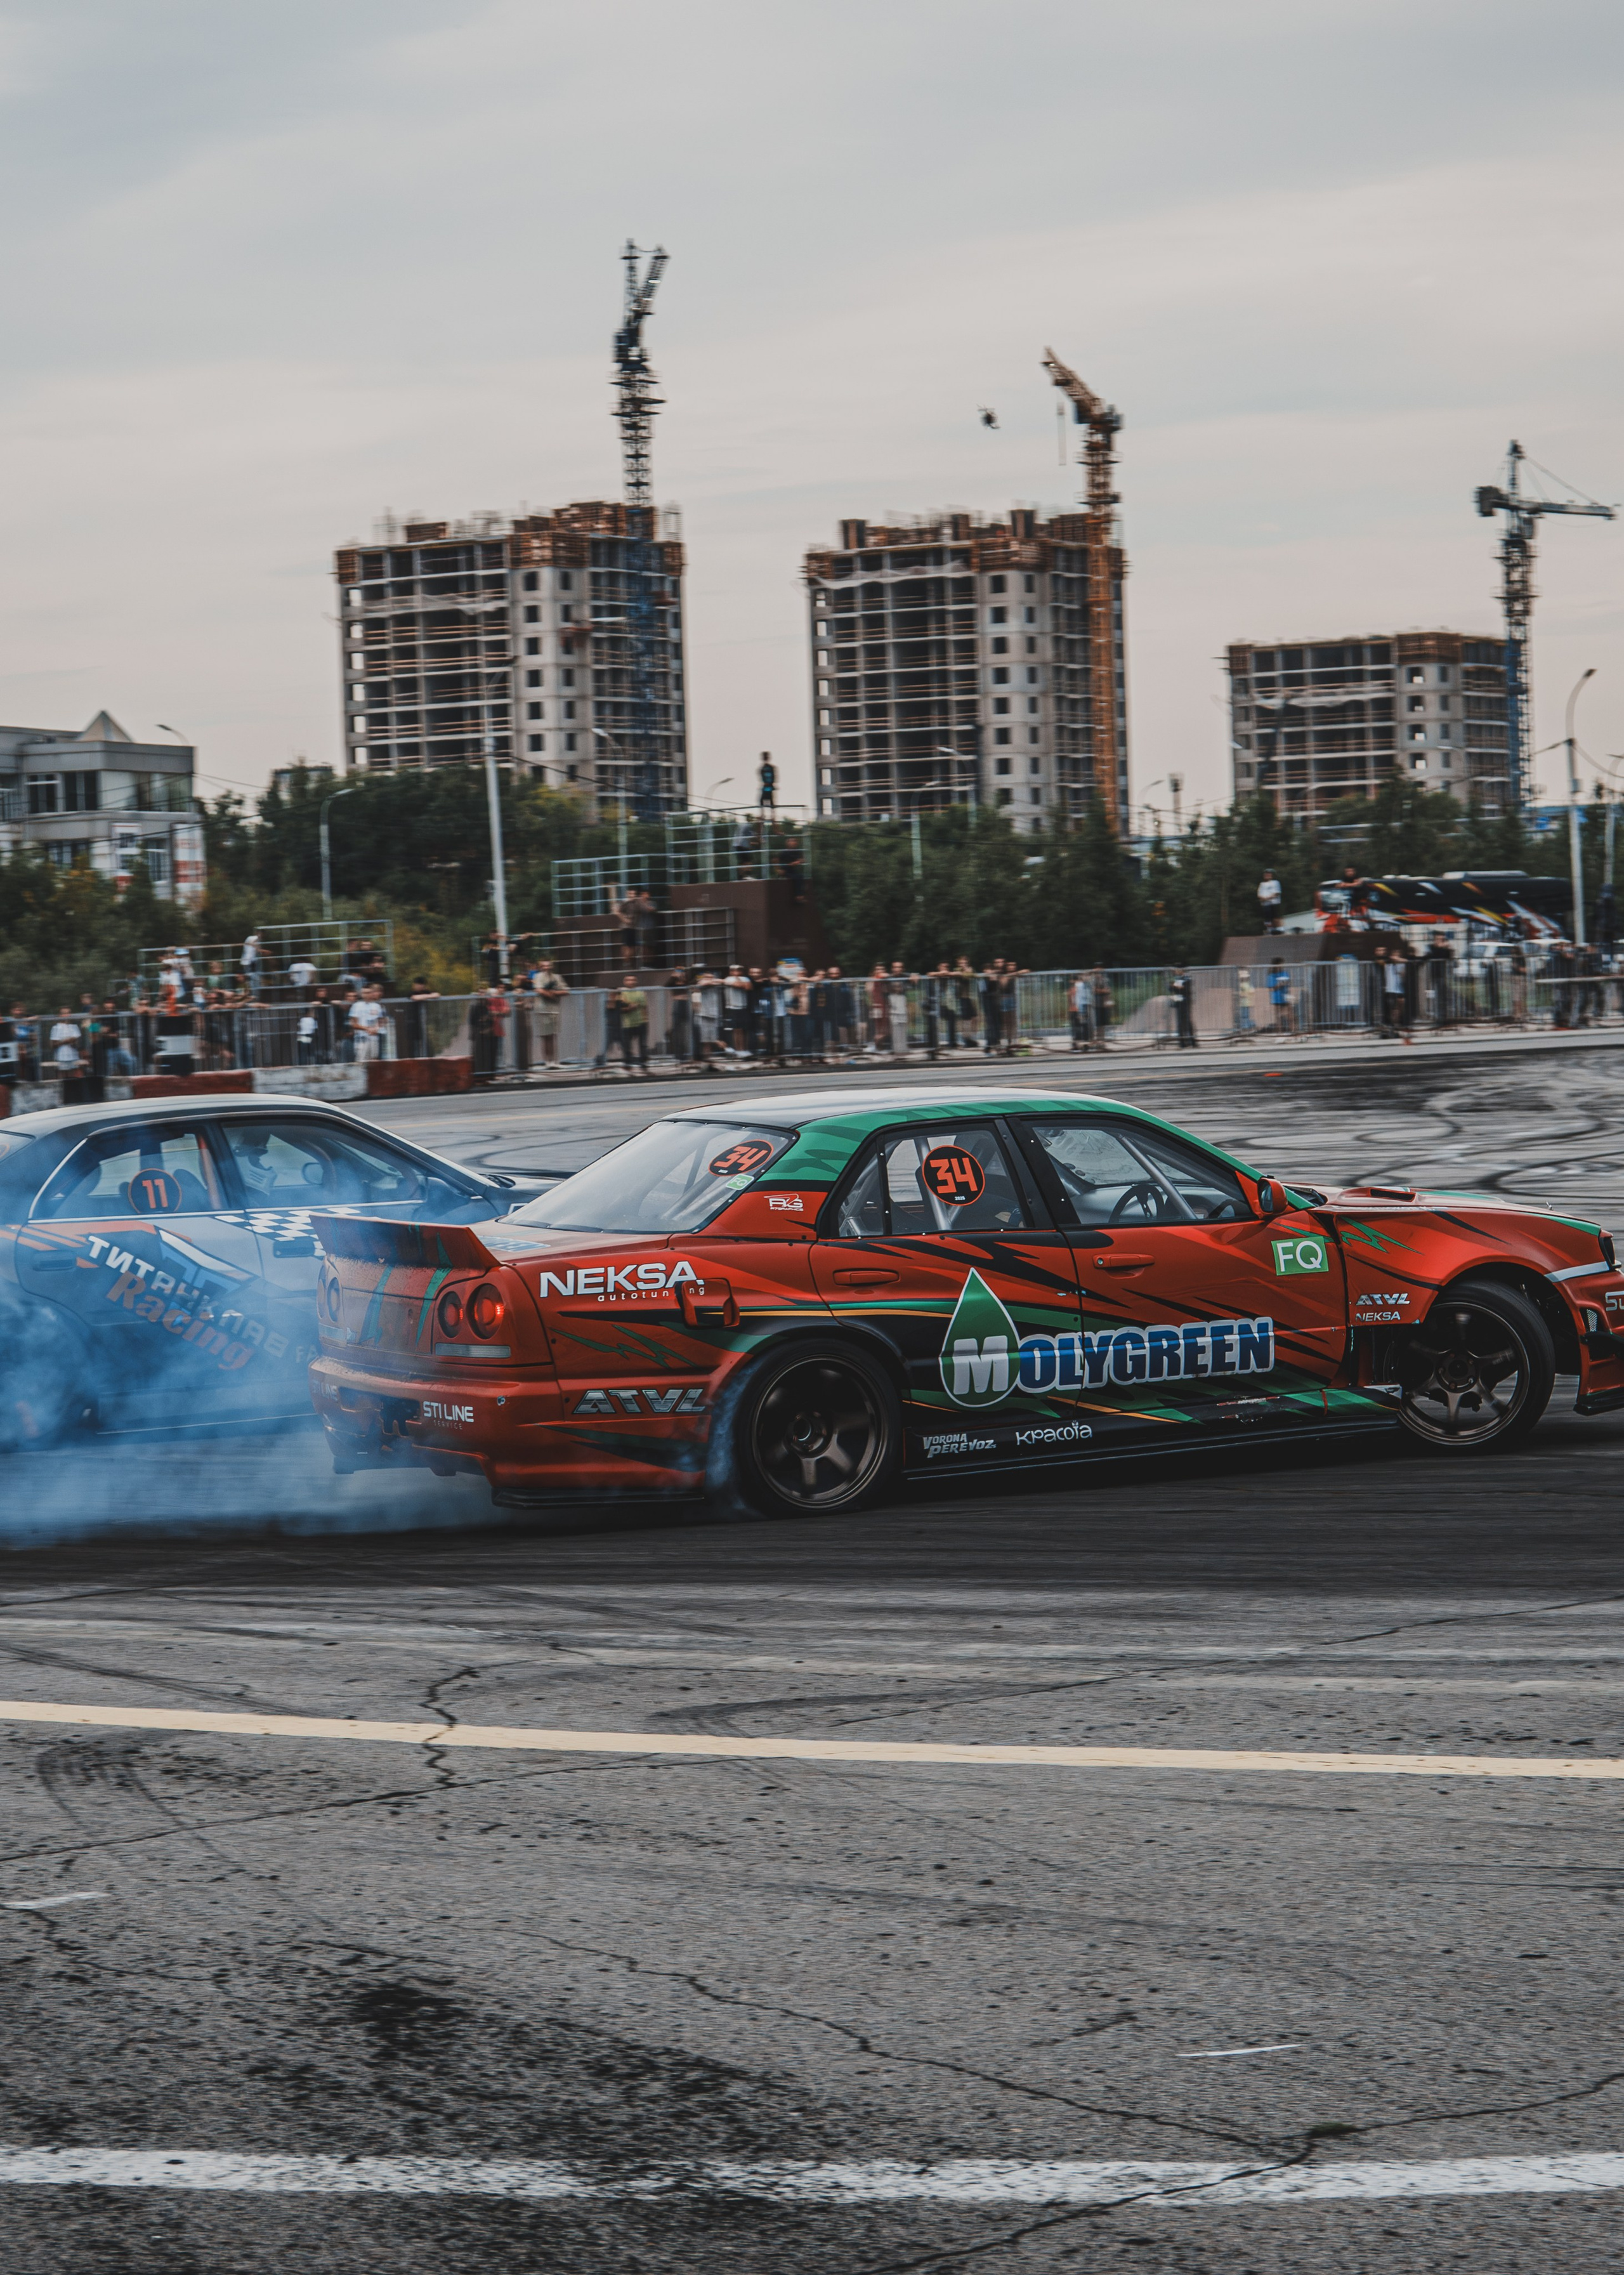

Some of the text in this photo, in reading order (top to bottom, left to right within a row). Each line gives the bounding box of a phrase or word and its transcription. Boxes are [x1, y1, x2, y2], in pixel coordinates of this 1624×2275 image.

[714, 1146, 768, 1171] 34
[730, 1177, 748, 1186] FQ
[929, 1157, 978, 1194] 34
[142, 1179, 168, 1209] 11
[1276, 1240, 1323, 1272] FQ
[540, 1261, 705, 1298] NEKSA
[598, 1287, 705, 1302] autotunng
[1356, 1293, 1410, 1306] ATVL
[106, 1271, 254, 1370] Racing
[1355, 1311, 1401, 1322] NEKSA
[952, 1317, 1274, 1396] MOLYGREEN
[573, 1389, 707, 1414] ATVL
[923, 1433, 967, 1450] VORONA
